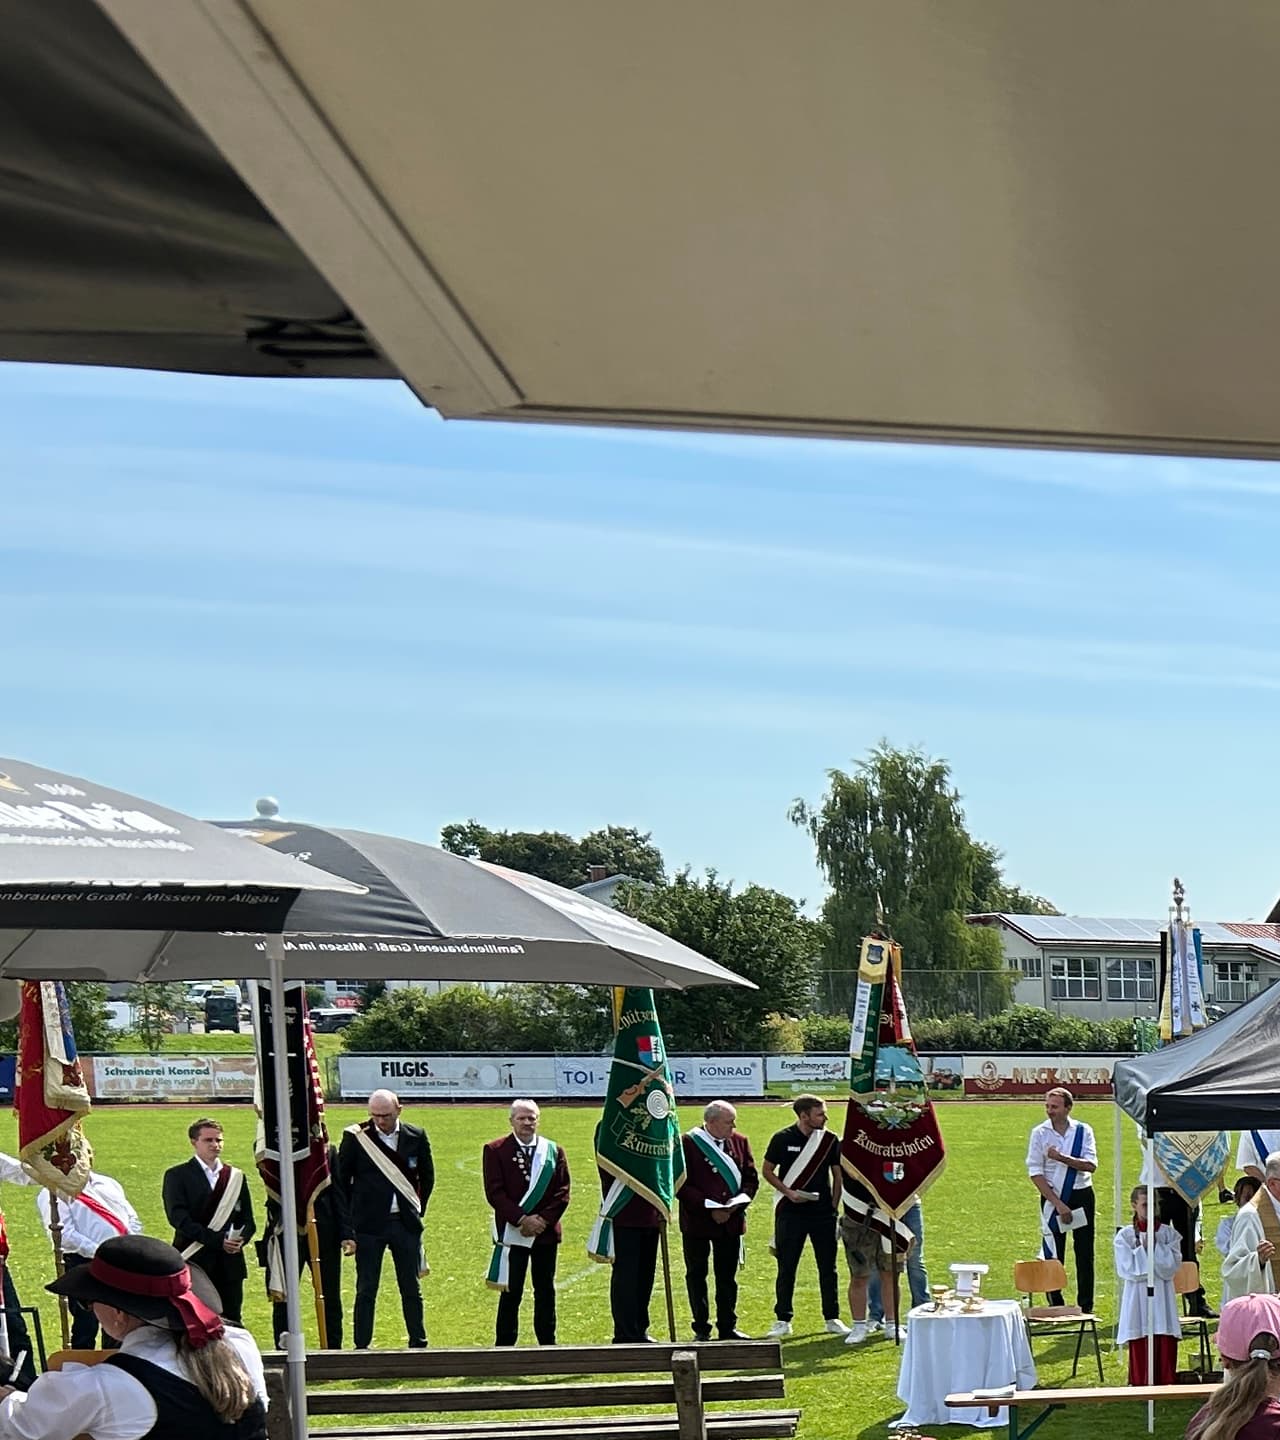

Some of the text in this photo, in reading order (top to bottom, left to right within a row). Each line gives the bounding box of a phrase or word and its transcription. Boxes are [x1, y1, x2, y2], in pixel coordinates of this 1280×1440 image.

[0, 892, 83, 901] nbrauerei
[142, 893, 201, 902] Missen
[205, 893, 227, 902] im
[105, 1066, 210, 1076] Schreinerei Konrad
[700, 1067, 751, 1077] KONRAD
[1013, 1068, 1111, 1083] MECKATZER
[853, 1129, 935, 1158] Kimratshofen
